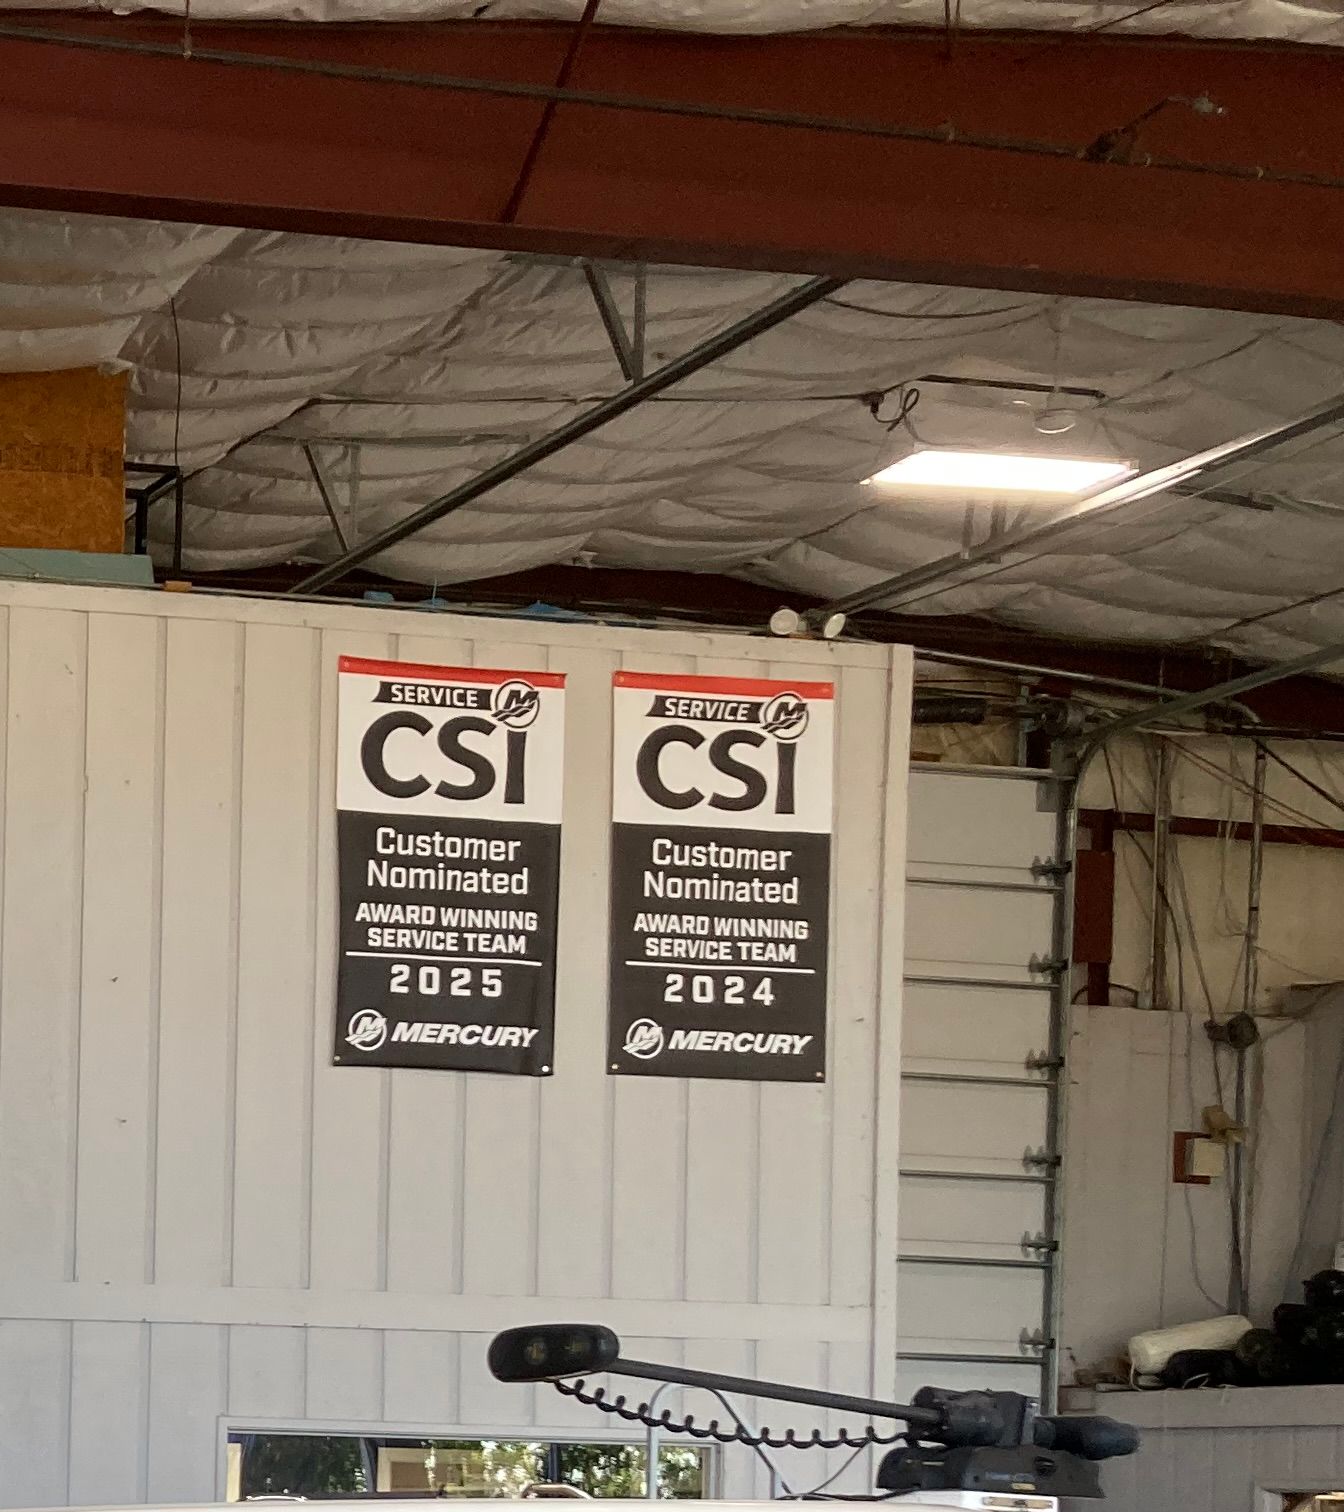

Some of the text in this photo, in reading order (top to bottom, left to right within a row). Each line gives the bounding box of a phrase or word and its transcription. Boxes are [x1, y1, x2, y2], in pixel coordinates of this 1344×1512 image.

[391, 684, 478, 708] SERVICE
[664, 698, 750, 721] SERVICE
[376, 827, 521, 861] Customer
[652, 838, 792, 871] Customer
[367, 859, 528, 895] Nominated
[644, 871, 798, 904] Nominated
[355, 902, 537, 930] AWARD WINNING
[634, 913, 808, 940] AWARD WINNING
[367, 928, 526, 954] SERVICE TEAM
[645, 938, 796, 962] SERVICE TEAM
[390, 964, 502, 998] 2025
[664, 974, 775, 1006] 2024
[391, 1021, 539, 1048] MERCURY
[668, 1030, 813, 1055] MERCURY
